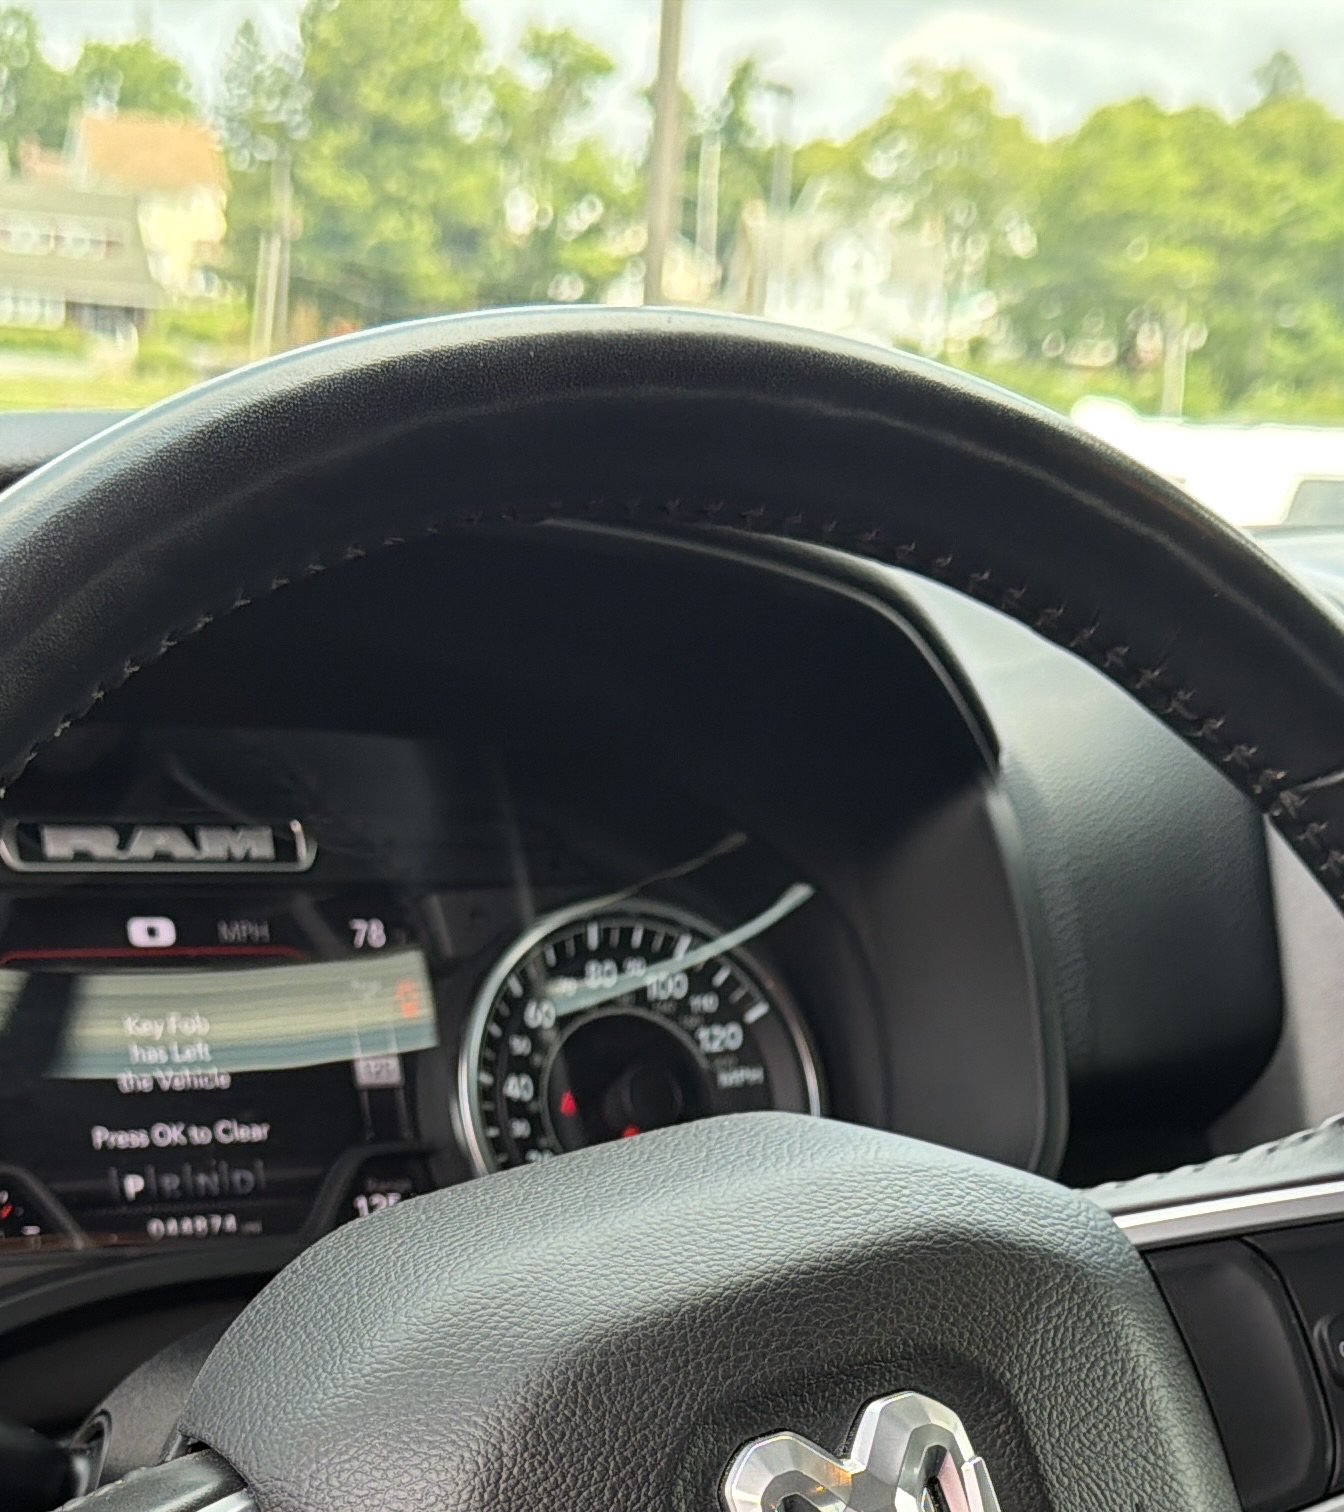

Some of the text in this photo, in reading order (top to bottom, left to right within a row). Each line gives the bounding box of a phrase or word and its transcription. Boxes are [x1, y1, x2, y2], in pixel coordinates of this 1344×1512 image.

[40, 824, 275, 861] RAM
[127, 916, 270, 948] 0 MPH
[585, 959, 619, 989] 80
[647, 970, 688, 1000] 100
[123, 1011, 210, 1040] Key Fob
[524, 1000, 556, 1029] 60
[171, 1041, 212, 1063] Left
[695, 1022, 743, 1053] 120
[117, 1066, 232, 1094] the Vehicle
[503, 1073, 534, 1101] 40
[91, 1118, 271, 1150] Press OK to Clear
